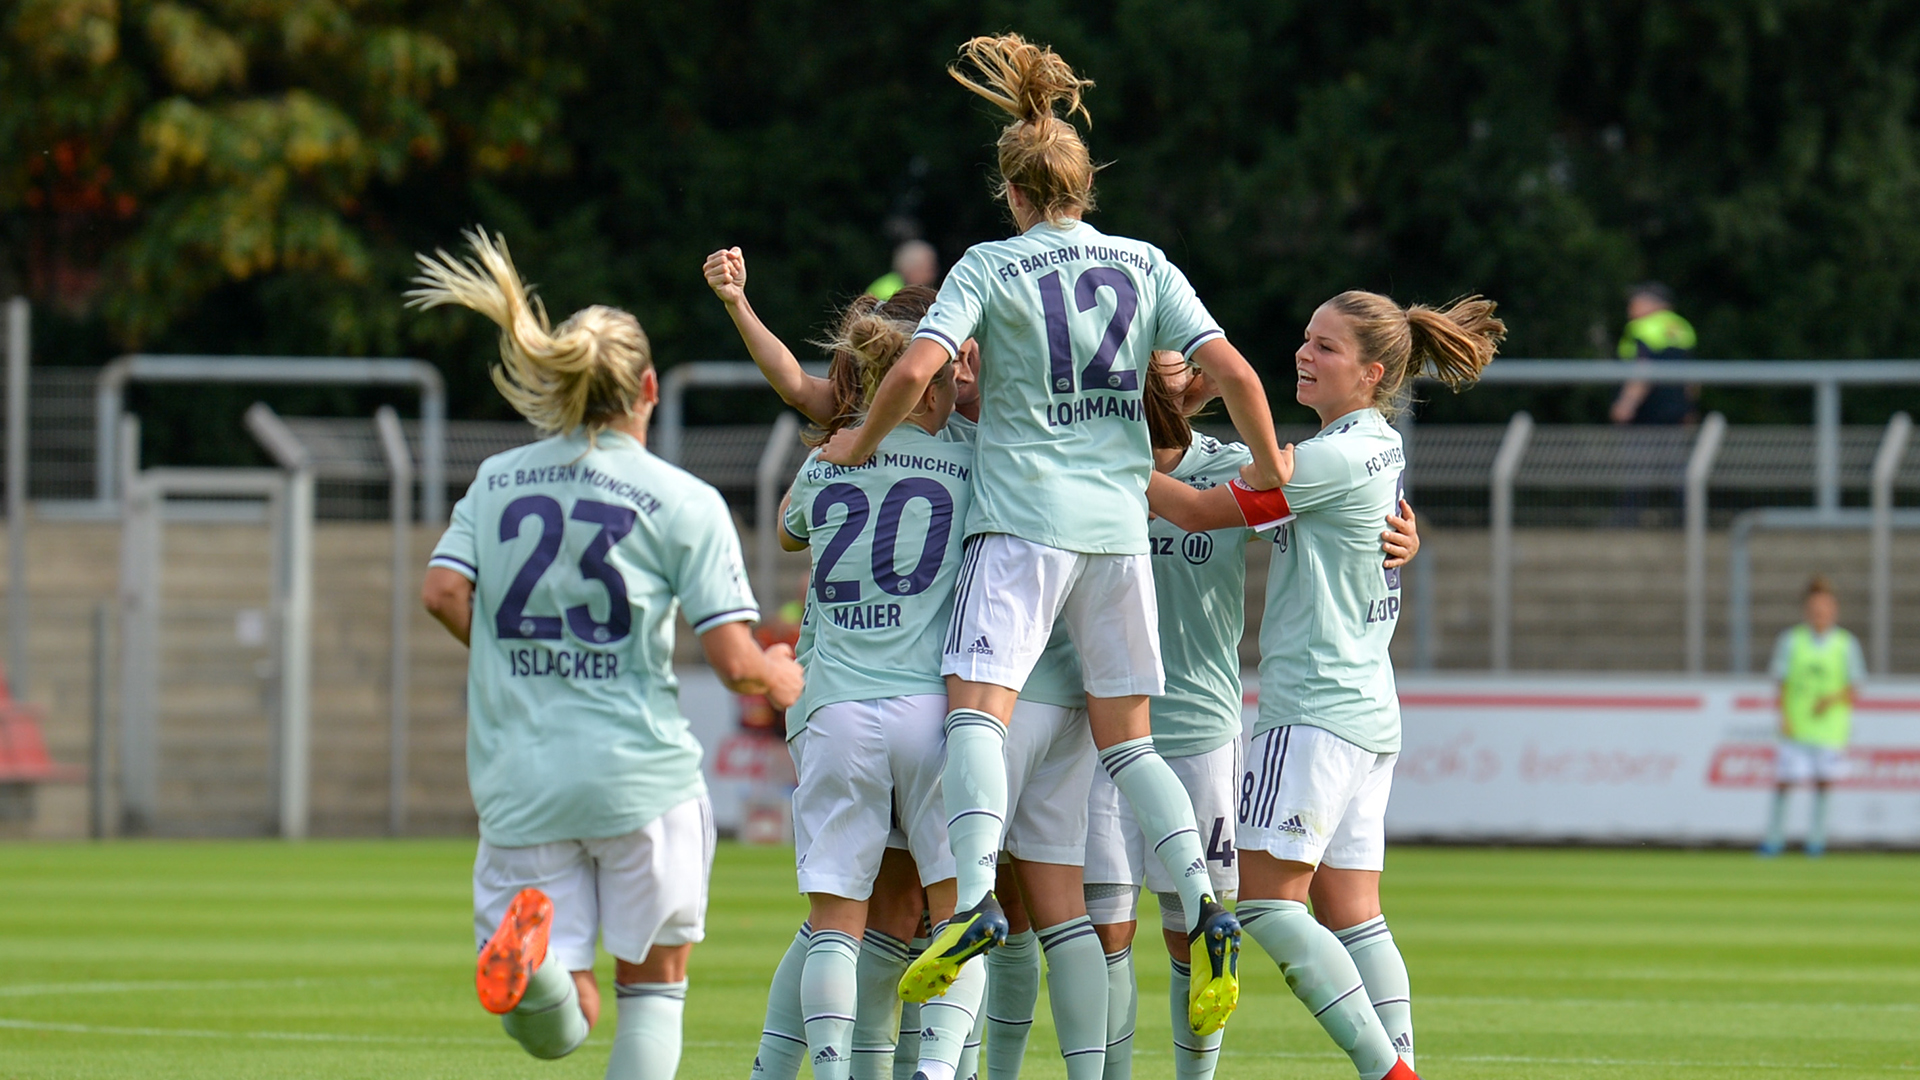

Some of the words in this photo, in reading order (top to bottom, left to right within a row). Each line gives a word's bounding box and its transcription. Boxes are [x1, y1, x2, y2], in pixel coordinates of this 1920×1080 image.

[998, 262, 1019, 282] FC
[1021, 245, 1080, 274] BAYERN
[1085, 245, 1154, 277] MÜNCHEN
[1038, 266, 1139, 395] 12
[488, 473, 509, 491] FC
[515, 464, 577, 486] BAYERN
[807, 468, 822, 484] FC
[884, 453, 970, 482] MÜNCHEN
[1365, 457, 1382, 477] FC
[811, 476, 954, 603] 20
[495, 495, 638, 644] 23
[833, 603, 902, 630] MAIER
[510, 649, 618, 679] ISLACKER
[967, 646, 994, 656] adidas
[1239, 771, 1255, 824] 8
[1207, 816, 1235, 868] 4
[1277, 824, 1307, 835] adidas
